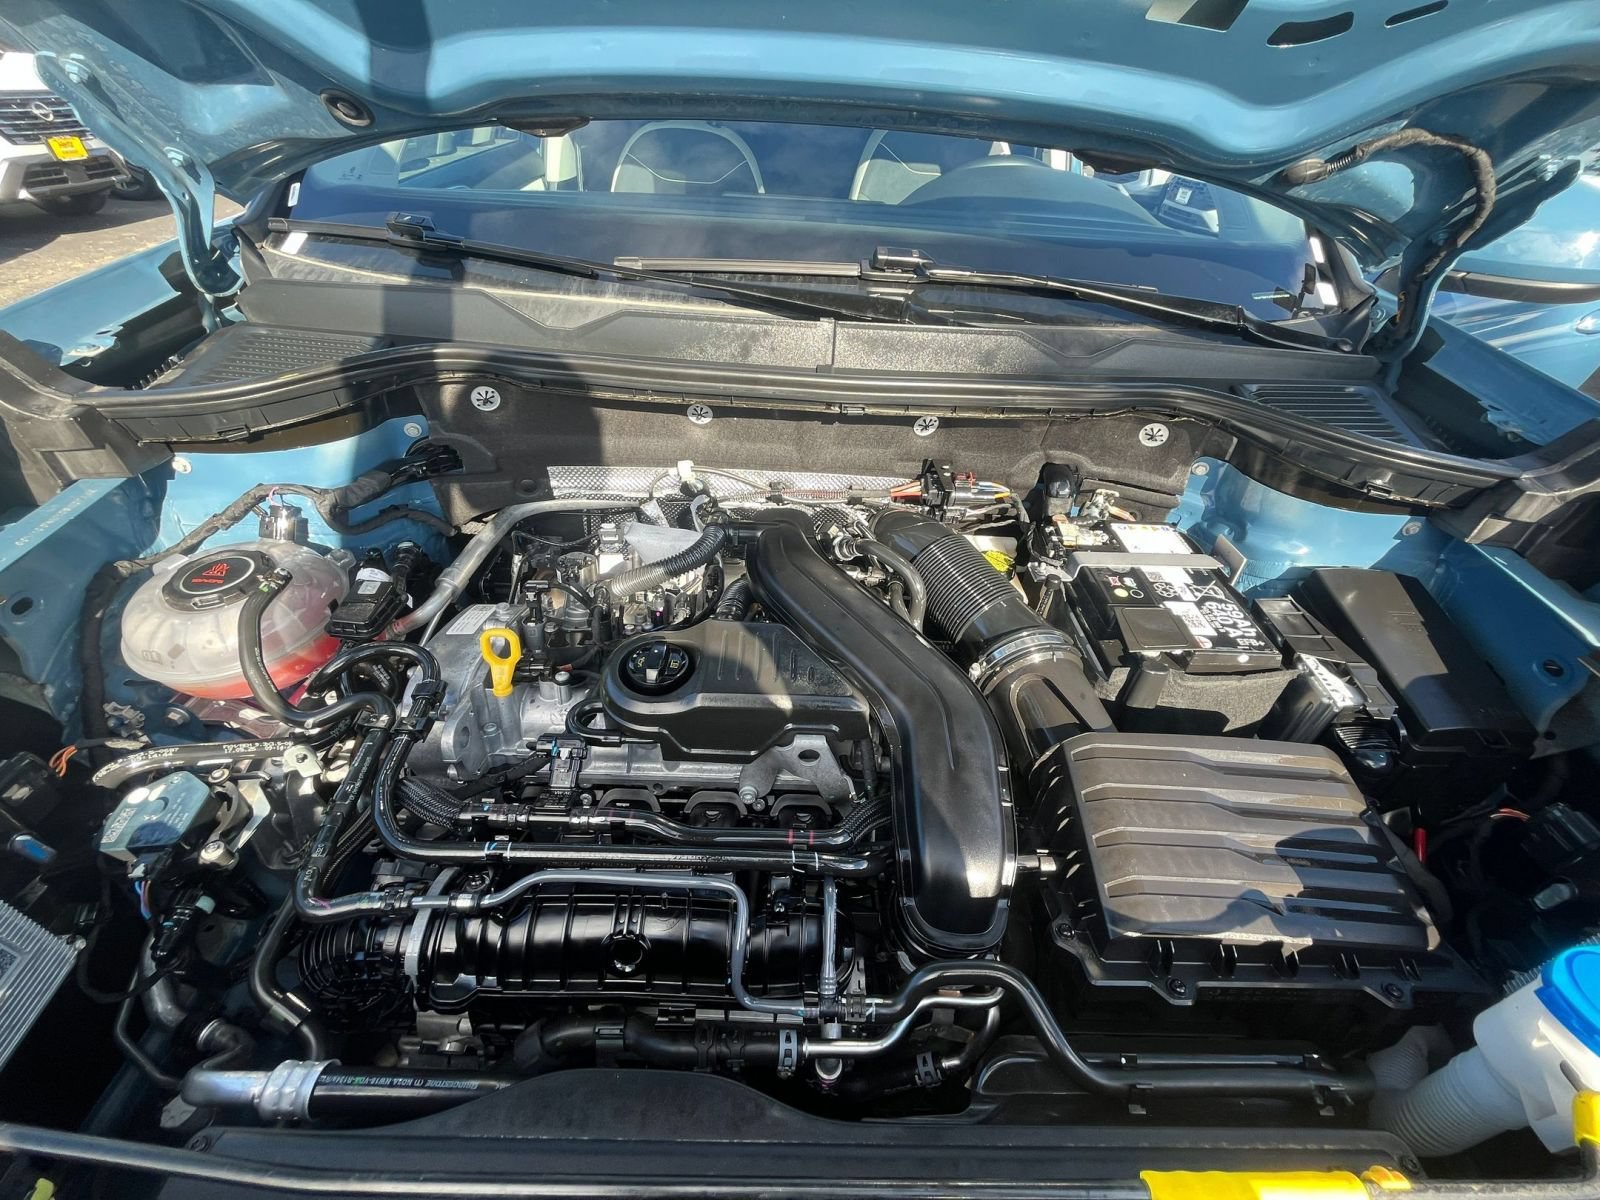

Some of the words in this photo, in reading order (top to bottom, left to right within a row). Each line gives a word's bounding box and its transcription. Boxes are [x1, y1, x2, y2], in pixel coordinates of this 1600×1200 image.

[1205, 601, 1233, 625] 640
[1224, 627, 1243, 638] A
[1222, 603, 1257, 637] 59Ah
[427, 1078, 480, 1090] BRIDGESTONE
